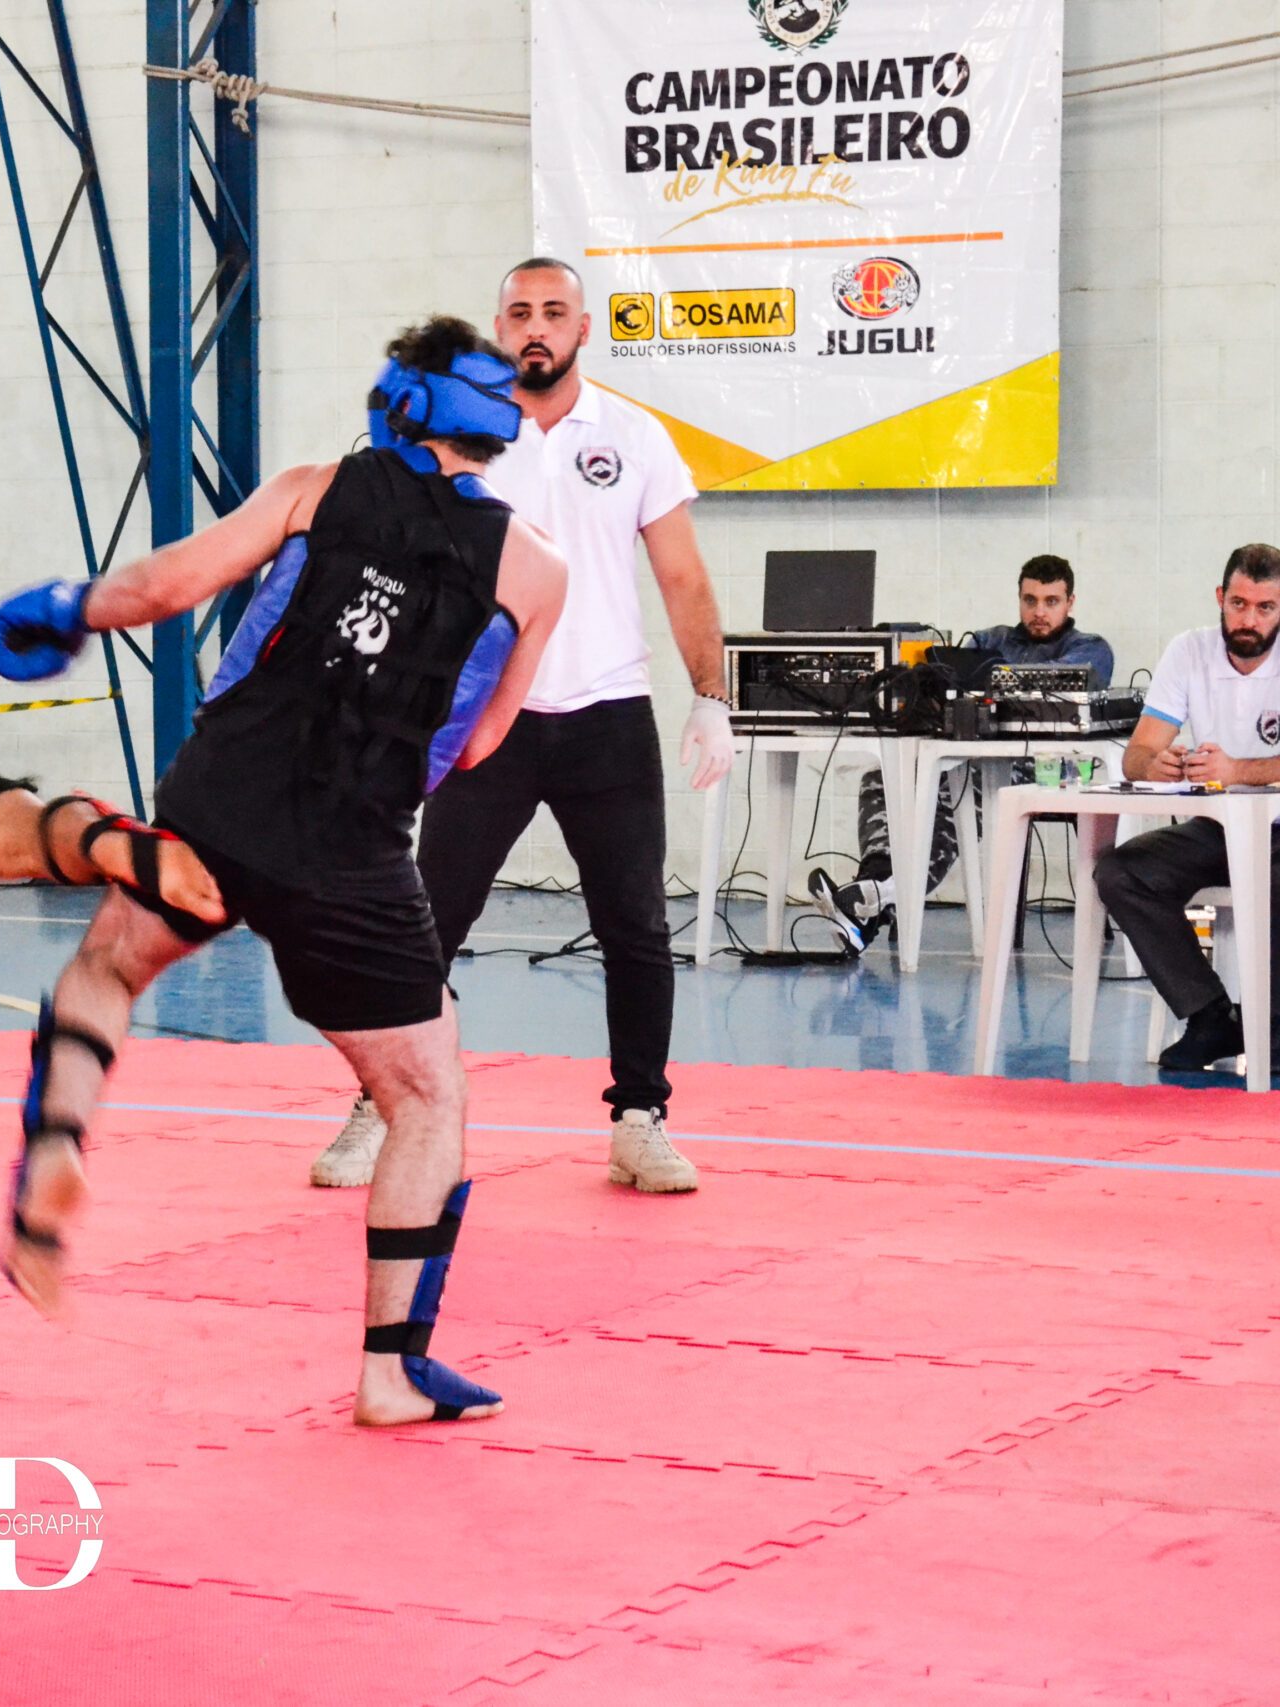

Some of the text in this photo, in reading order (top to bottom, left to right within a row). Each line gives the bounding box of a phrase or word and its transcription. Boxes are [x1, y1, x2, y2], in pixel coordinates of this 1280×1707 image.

[624, 52, 971, 115] CAMPEONATO
[624, 106, 971, 174] BRASILEIRO
[663, 147, 857, 203] de Kung Fu
[671, 301, 787, 328] COSAMA
[817, 326, 935, 356] JUGUI
